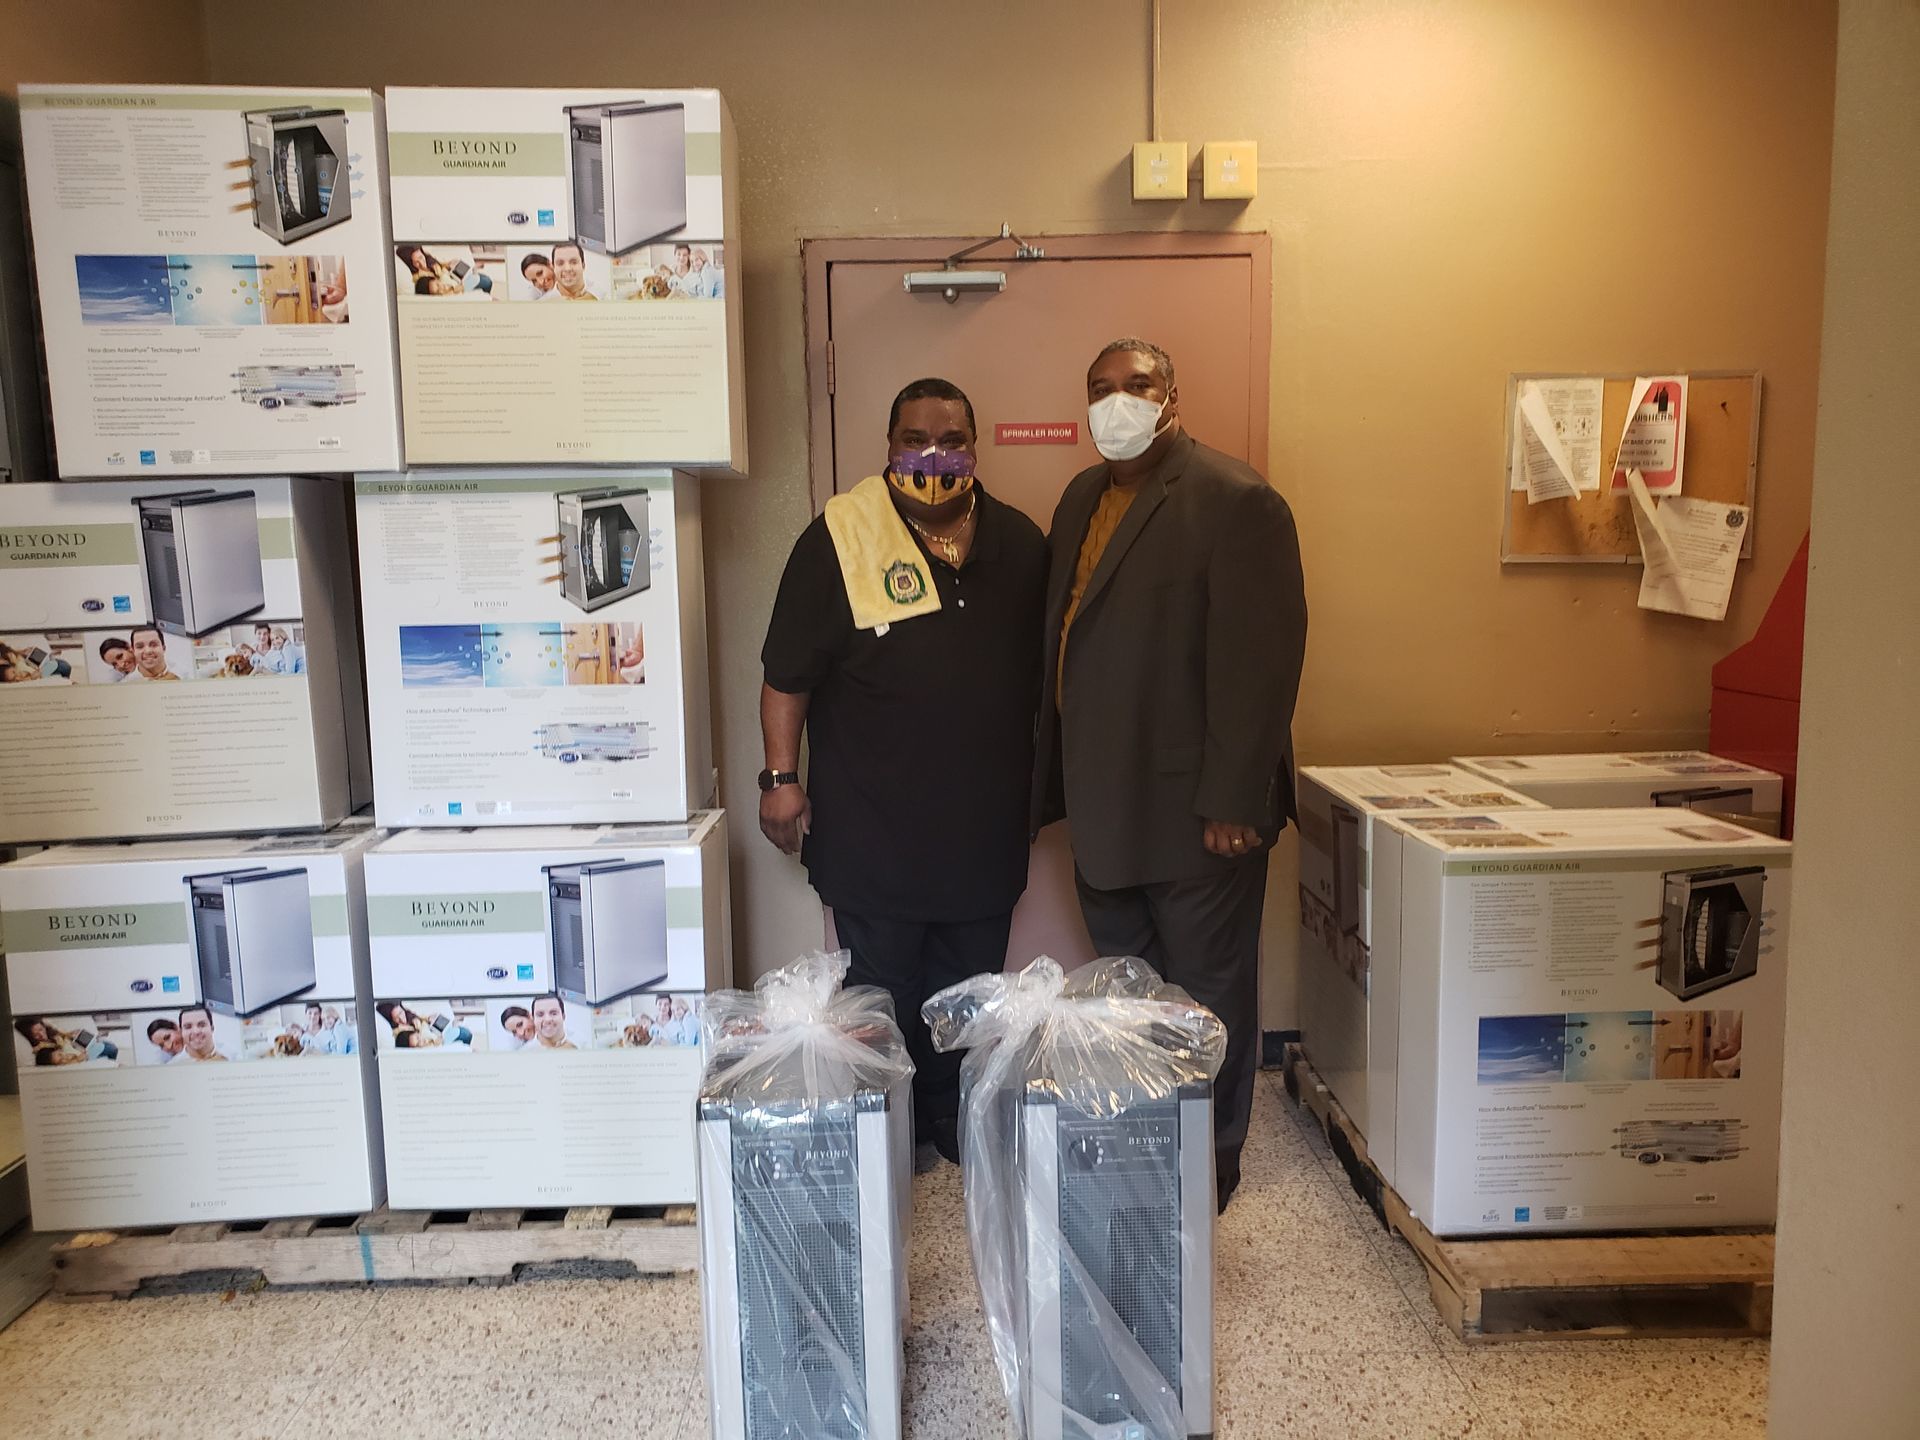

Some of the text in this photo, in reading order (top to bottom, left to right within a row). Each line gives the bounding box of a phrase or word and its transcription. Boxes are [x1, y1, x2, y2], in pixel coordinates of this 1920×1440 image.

[45, 96, 157, 107] BEYOND GUARDIAN AIR
[432, 139, 517, 155] BEYOND
[443, 160, 507, 169] GUARDIAN AIR
[1002, 428, 1072, 438] SPRINKLER ROOM
[556, 441, 591, 449] BEYOND
[378, 485, 413, 493] BEYOND
[464, 483, 479, 491] AIR
[10, 551, 77, 561] GUARDIAN AIR
[146, 814, 183, 823] BEYOND
[1471, 863, 1580, 873] BEYOND GUARDIAN AIR
[411, 900, 496, 916] BEYOND
[48, 912, 138, 931] BEYOND
[421, 919, 486, 929] GUARDIAN AIR
[60, 931, 127, 943] GUARDIAN AIR
[1560, 988, 1598, 997] BEYOND
[1128, 1136, 1171, 1145] BEYOND
[805, 1149, 849, 1160] BEYOND
